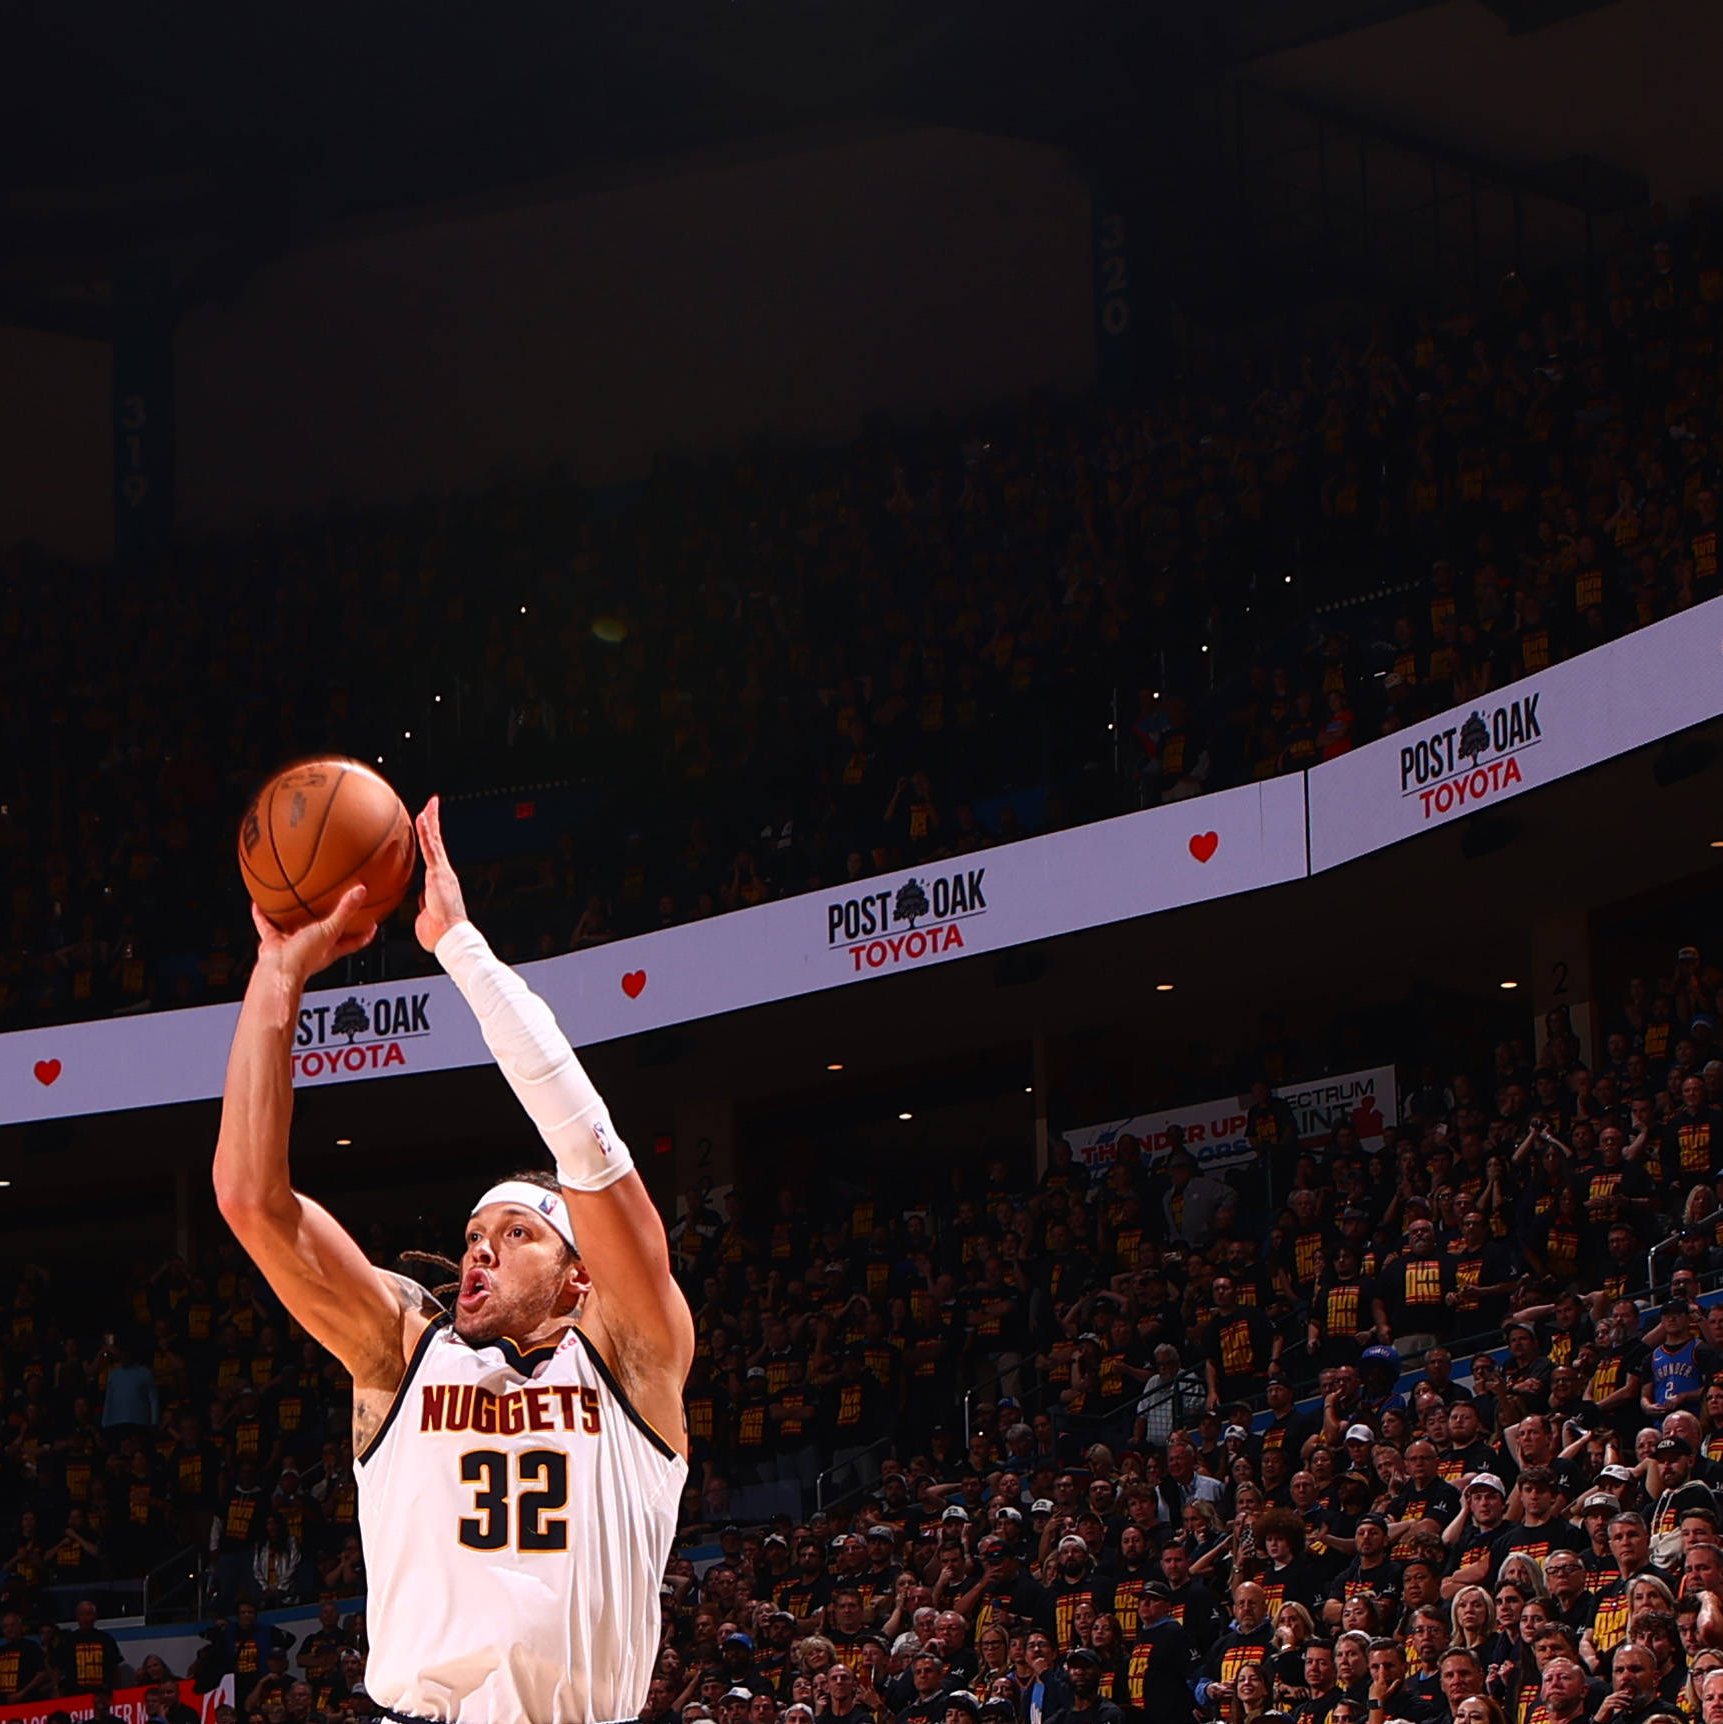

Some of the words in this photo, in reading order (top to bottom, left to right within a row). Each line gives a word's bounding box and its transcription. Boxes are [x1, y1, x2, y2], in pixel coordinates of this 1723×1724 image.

[1401, 727, 1456, 791] POST
[1493, 692, 1541, 752] OAK
[1419, 757, 1522, 818] TOYOTA
[828, 891, 893, 944] POST
[933, 868, 988, 917] OAK
[849, 924, 964, 972] TOYOTA
[296, 1007, 330, 1045] ST
[374, 993, 430, 1036] OAK
[292, 1043, 406, 1079] TOYOTA
[1286, 1078, 1374, 1109] ECTRUM
[420, 1384, 603, 1436] NUGGETS
[457, 1449, 570, 1553] 32
